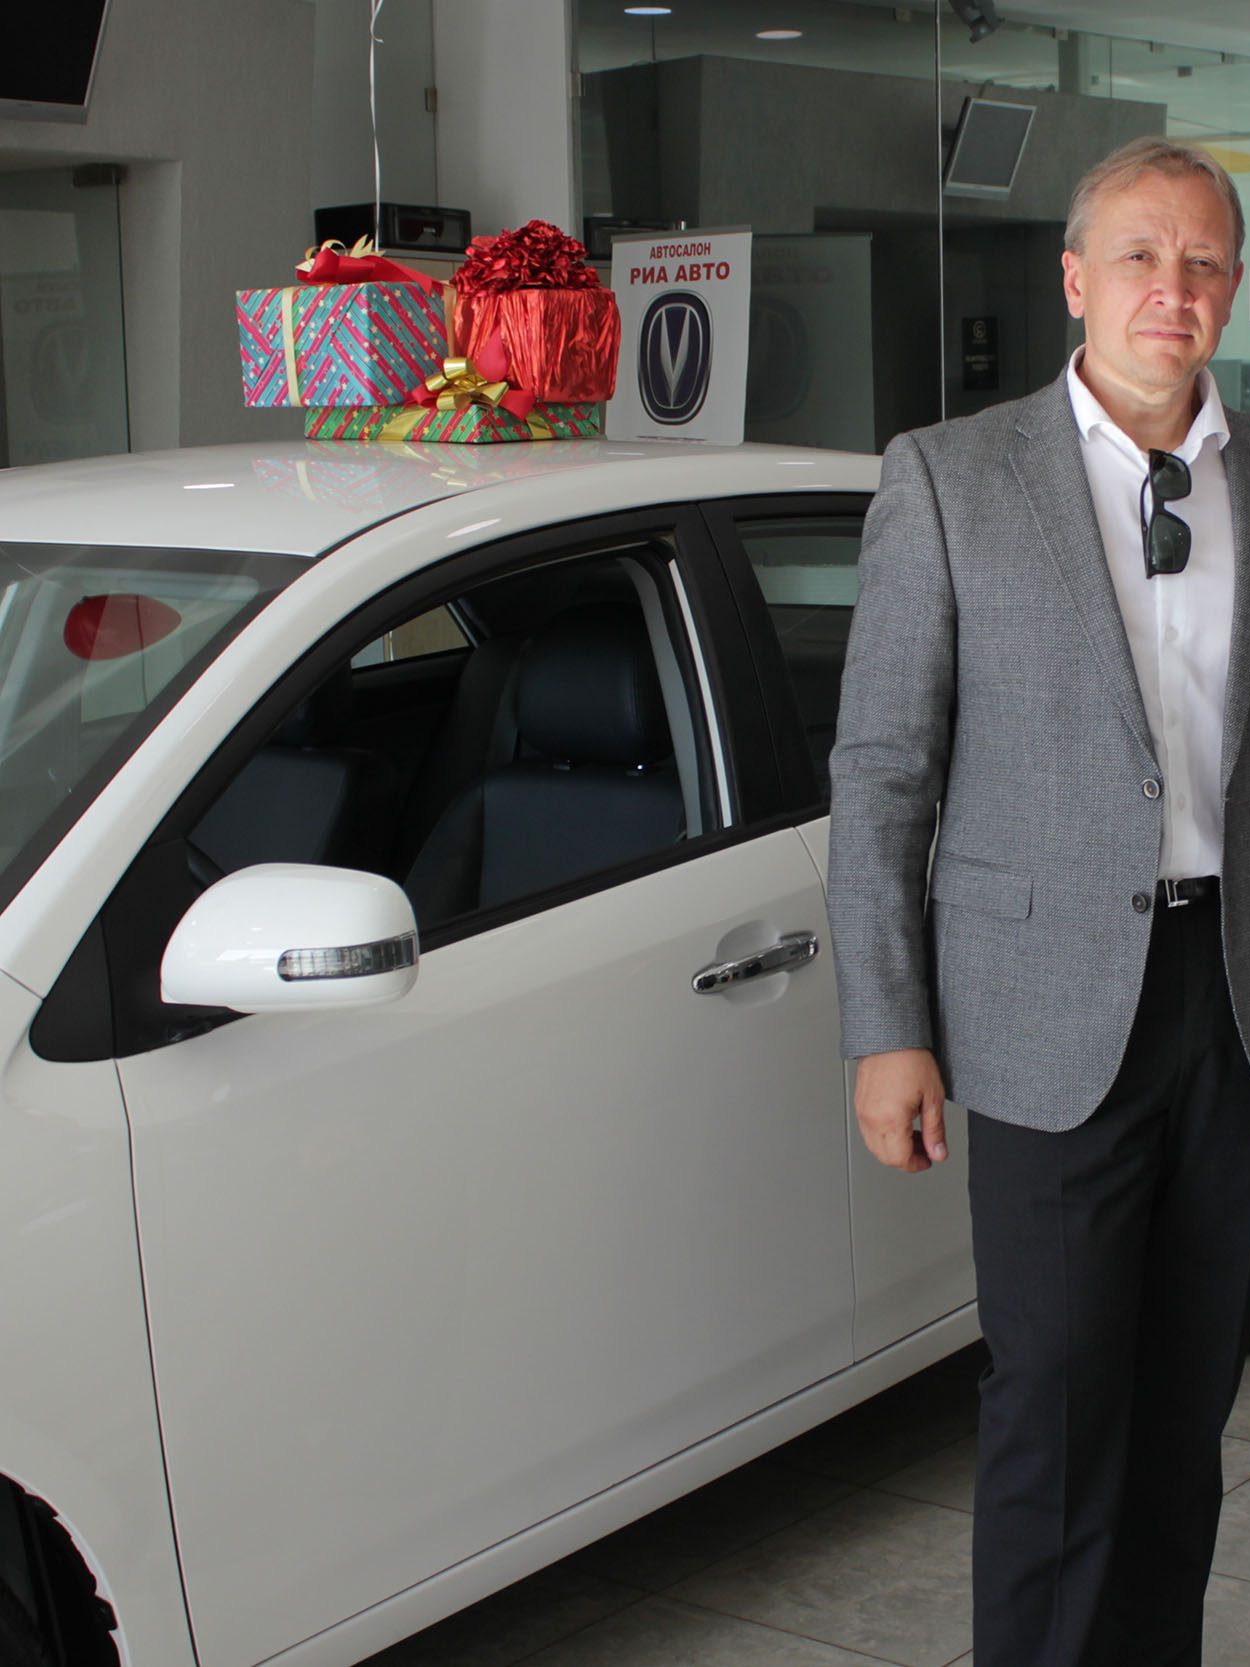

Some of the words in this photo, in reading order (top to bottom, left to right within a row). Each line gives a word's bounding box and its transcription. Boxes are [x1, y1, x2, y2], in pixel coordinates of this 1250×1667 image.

[650, 242, 711, 260] АВТОСАЛОН
[630, 265, 668, 285] РИА
[675, 262, 731, 283] АВТО
